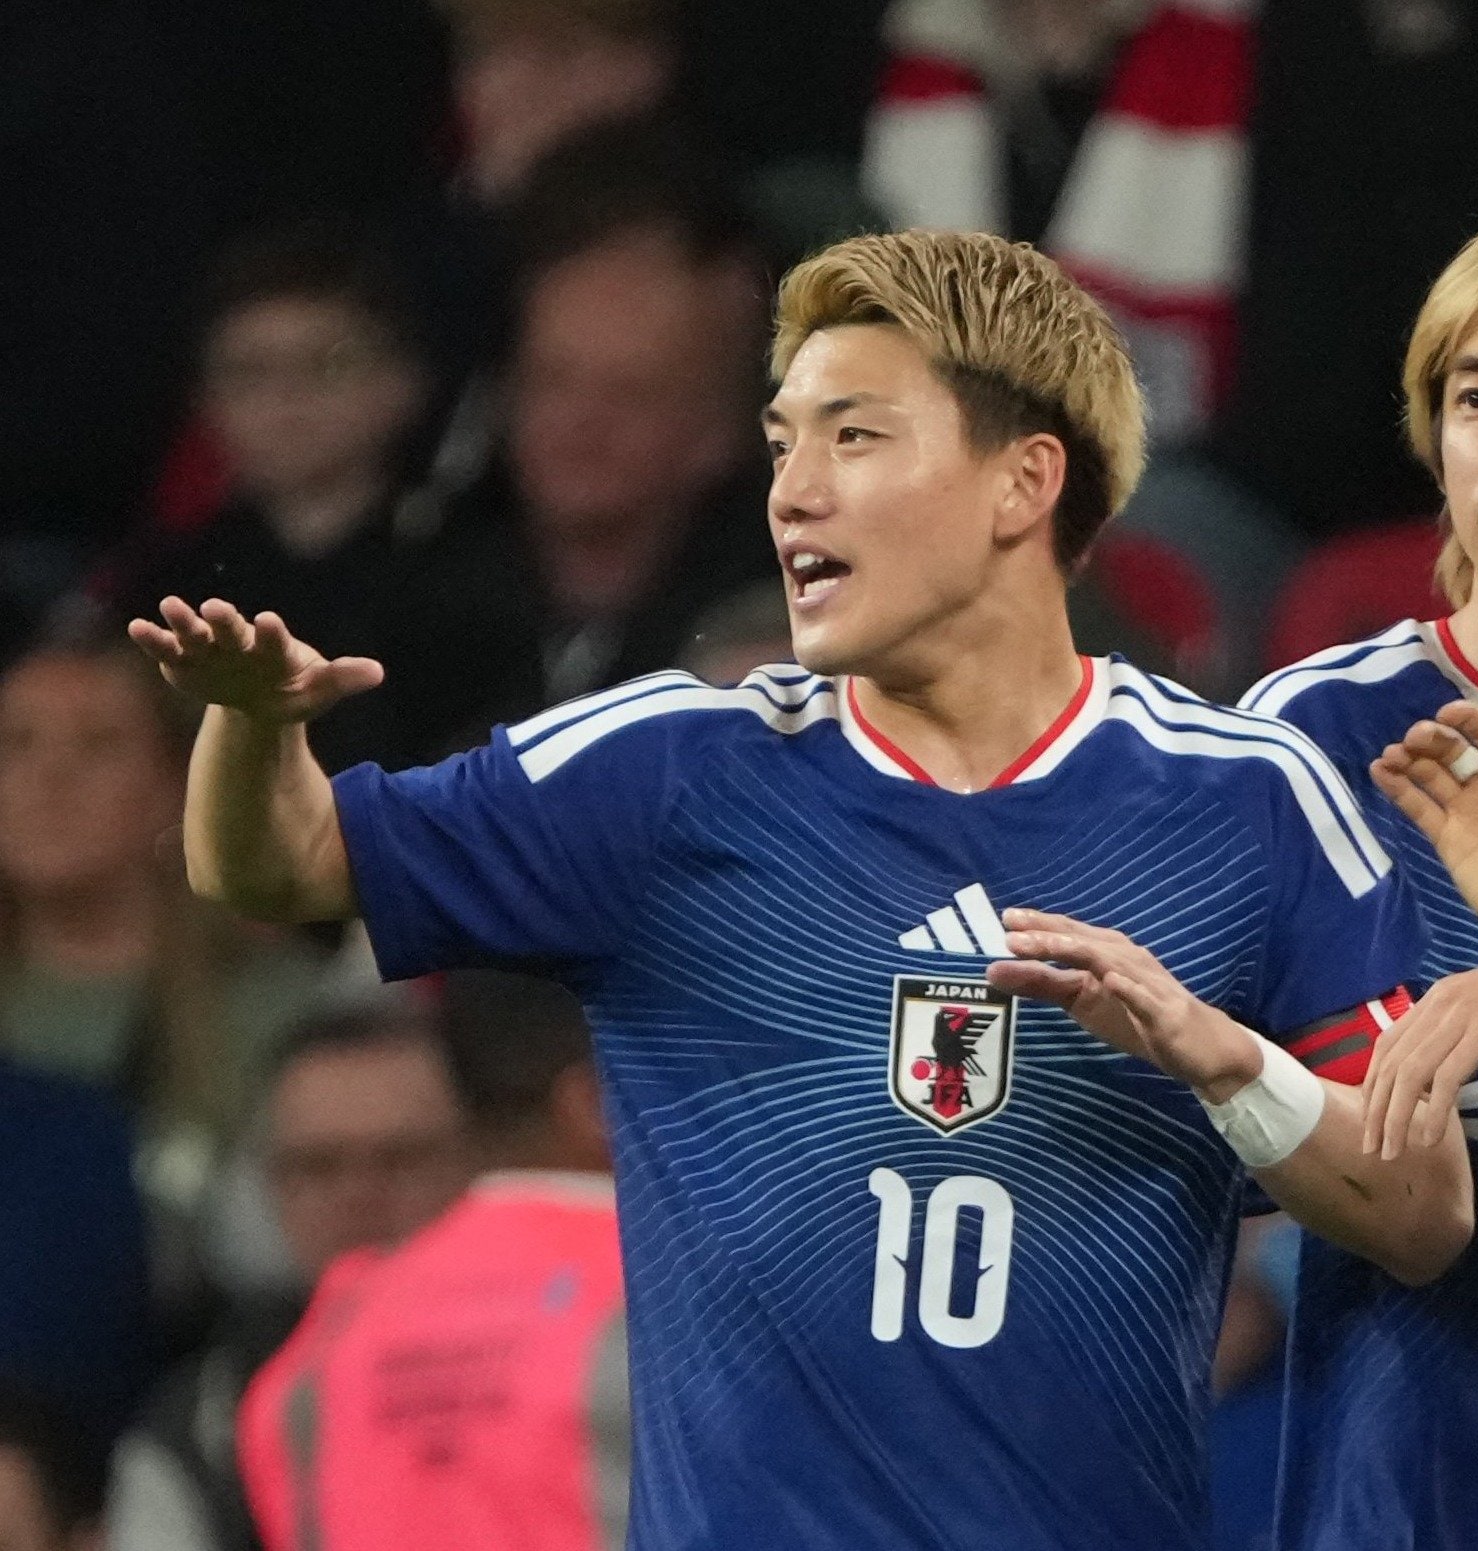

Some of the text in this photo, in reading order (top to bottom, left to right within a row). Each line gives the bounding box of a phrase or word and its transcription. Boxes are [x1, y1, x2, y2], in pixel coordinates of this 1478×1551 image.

[925, 984, 987, 999] JAPAN
[921, 1084, 973, 1107] JFA
[868, 1167, 1013, 1348] 10
